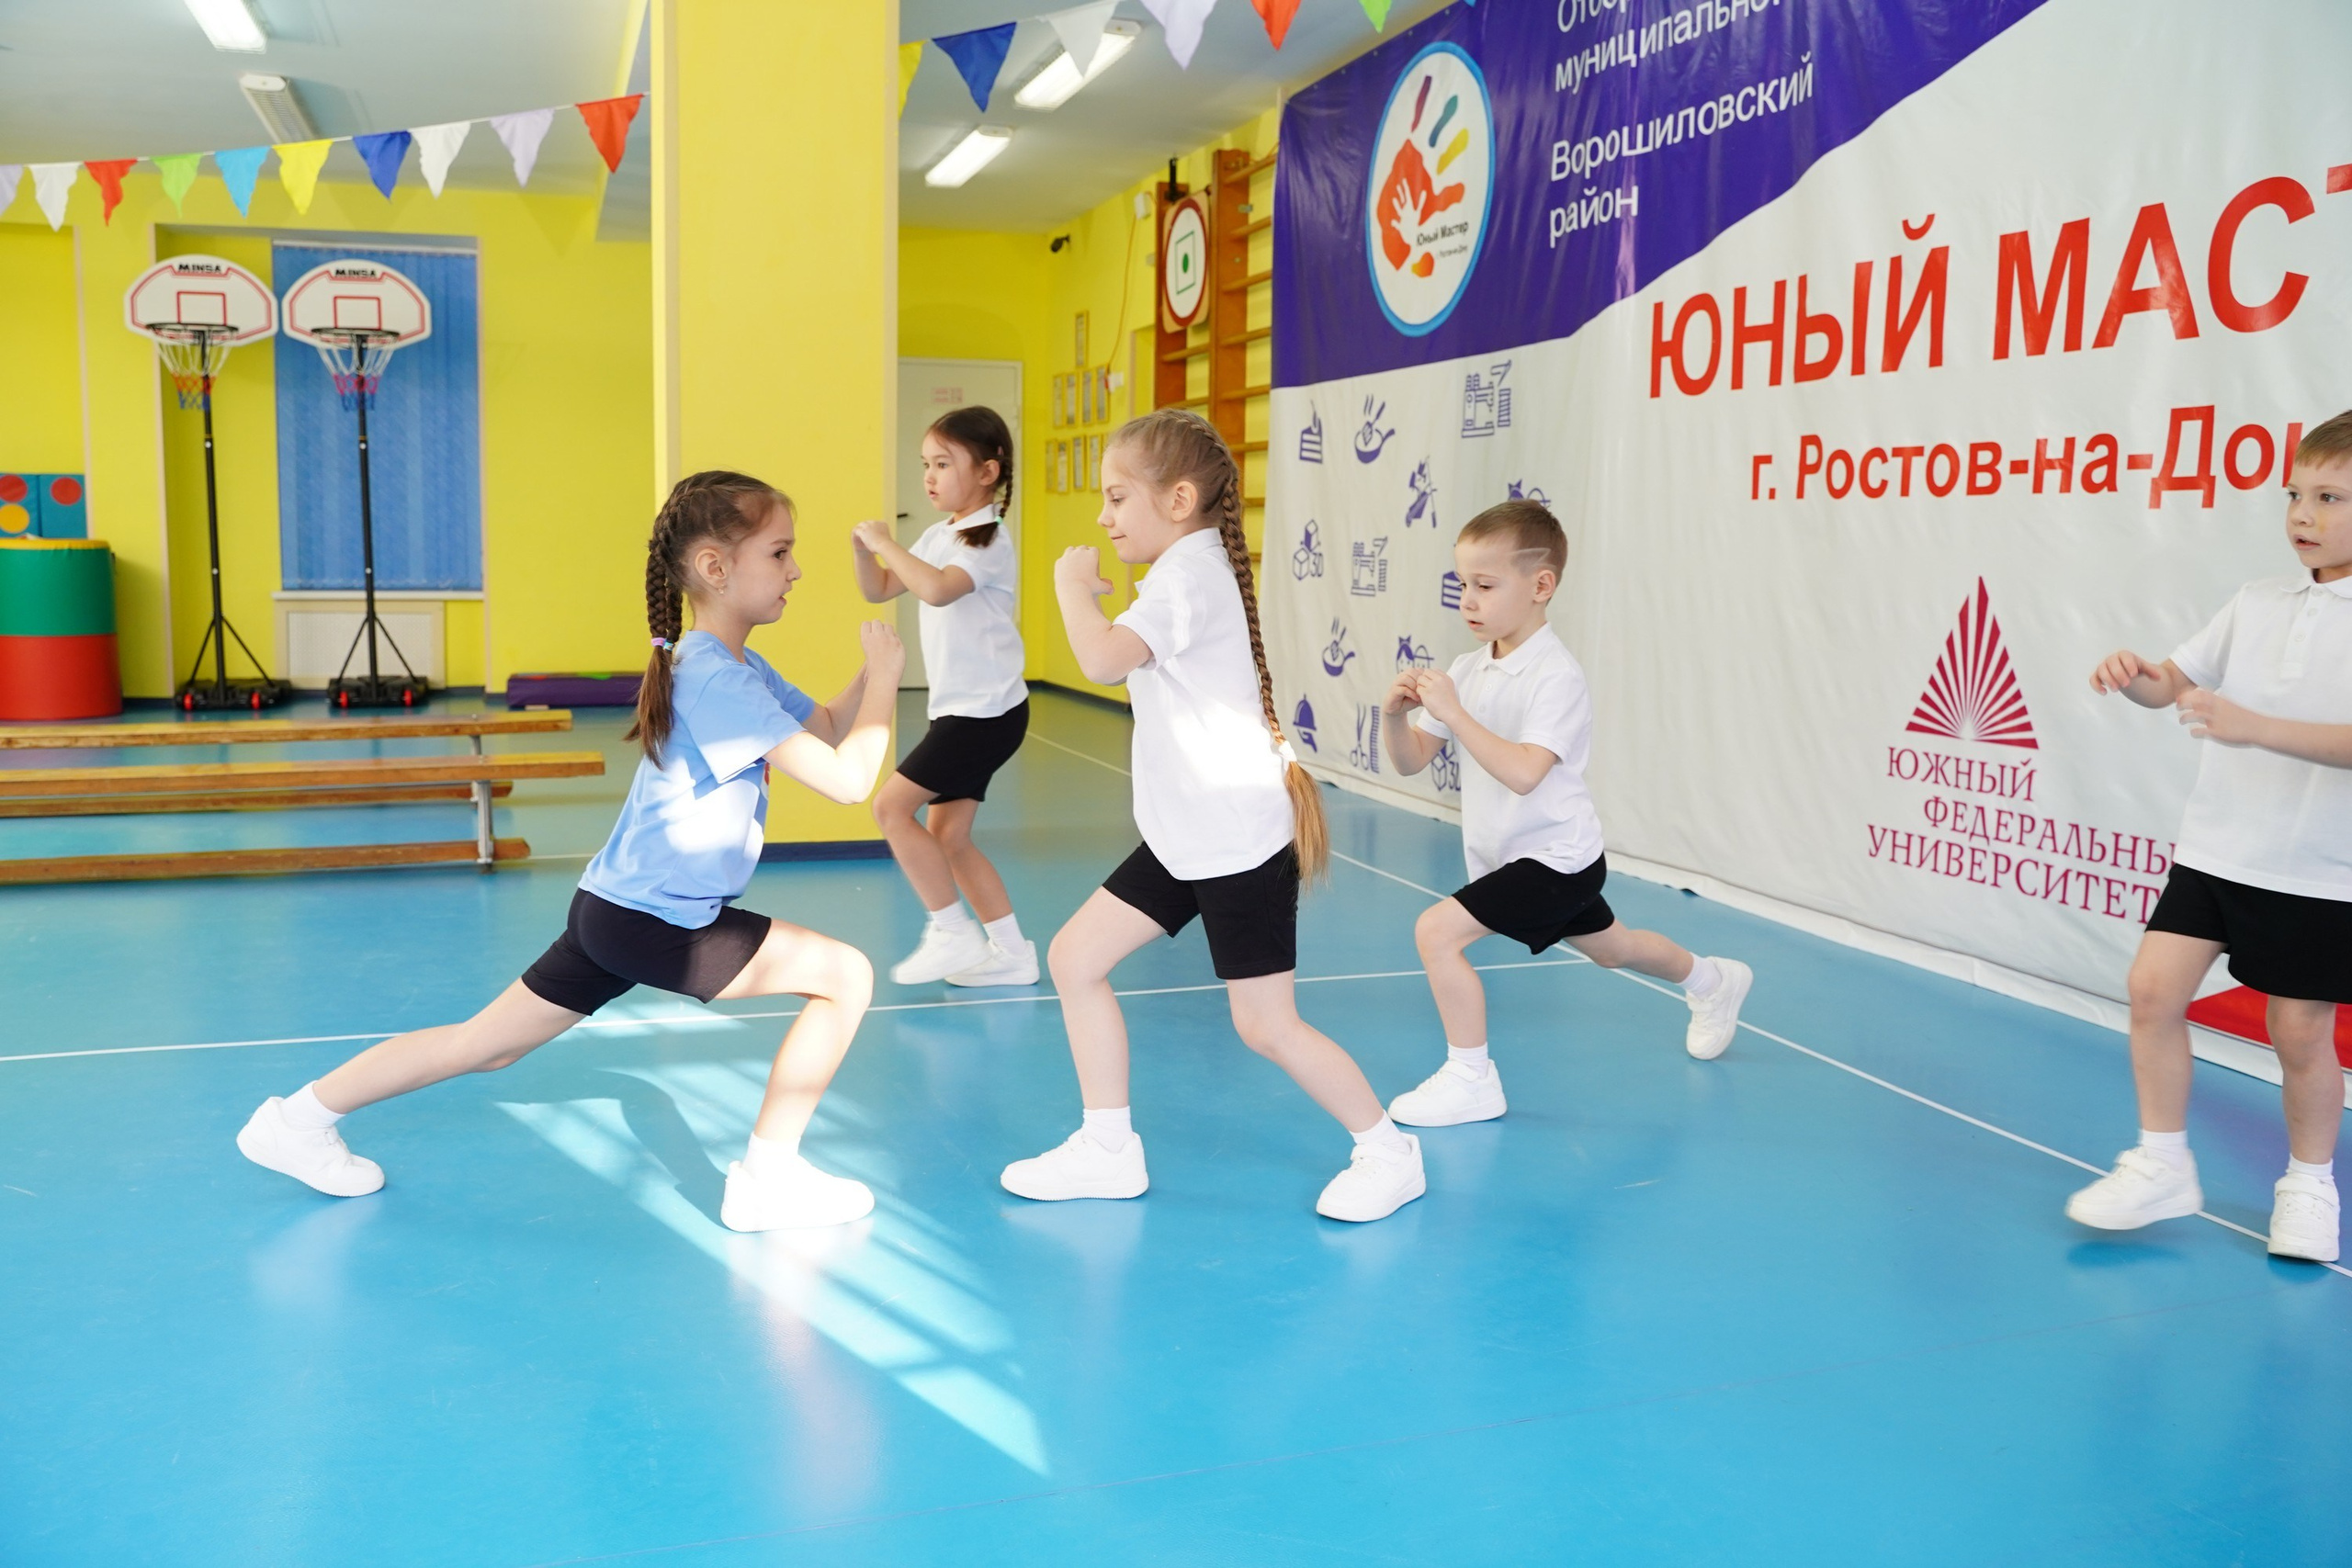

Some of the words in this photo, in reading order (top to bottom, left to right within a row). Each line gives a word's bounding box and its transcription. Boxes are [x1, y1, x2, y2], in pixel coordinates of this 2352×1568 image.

[1555, 0, 1781, 94] муниципальн
[1551, 51, 1814, 181] Ворошиловский
[1550, 186, 1639, 248] район
[178, 263, 221, 274] MINSA
[1649, 213, 1950, 399] ЮНЫЙ
[1750, 455, 1776, 501] г.
[1887, 747, 2037, 802] ЮЖНЫЙ
[1867, 824, 2161, 924] УНИВЕРСИТЕТ
[1924, 795, 2177, 875] ФЕДЕРАЛЬНЫ
